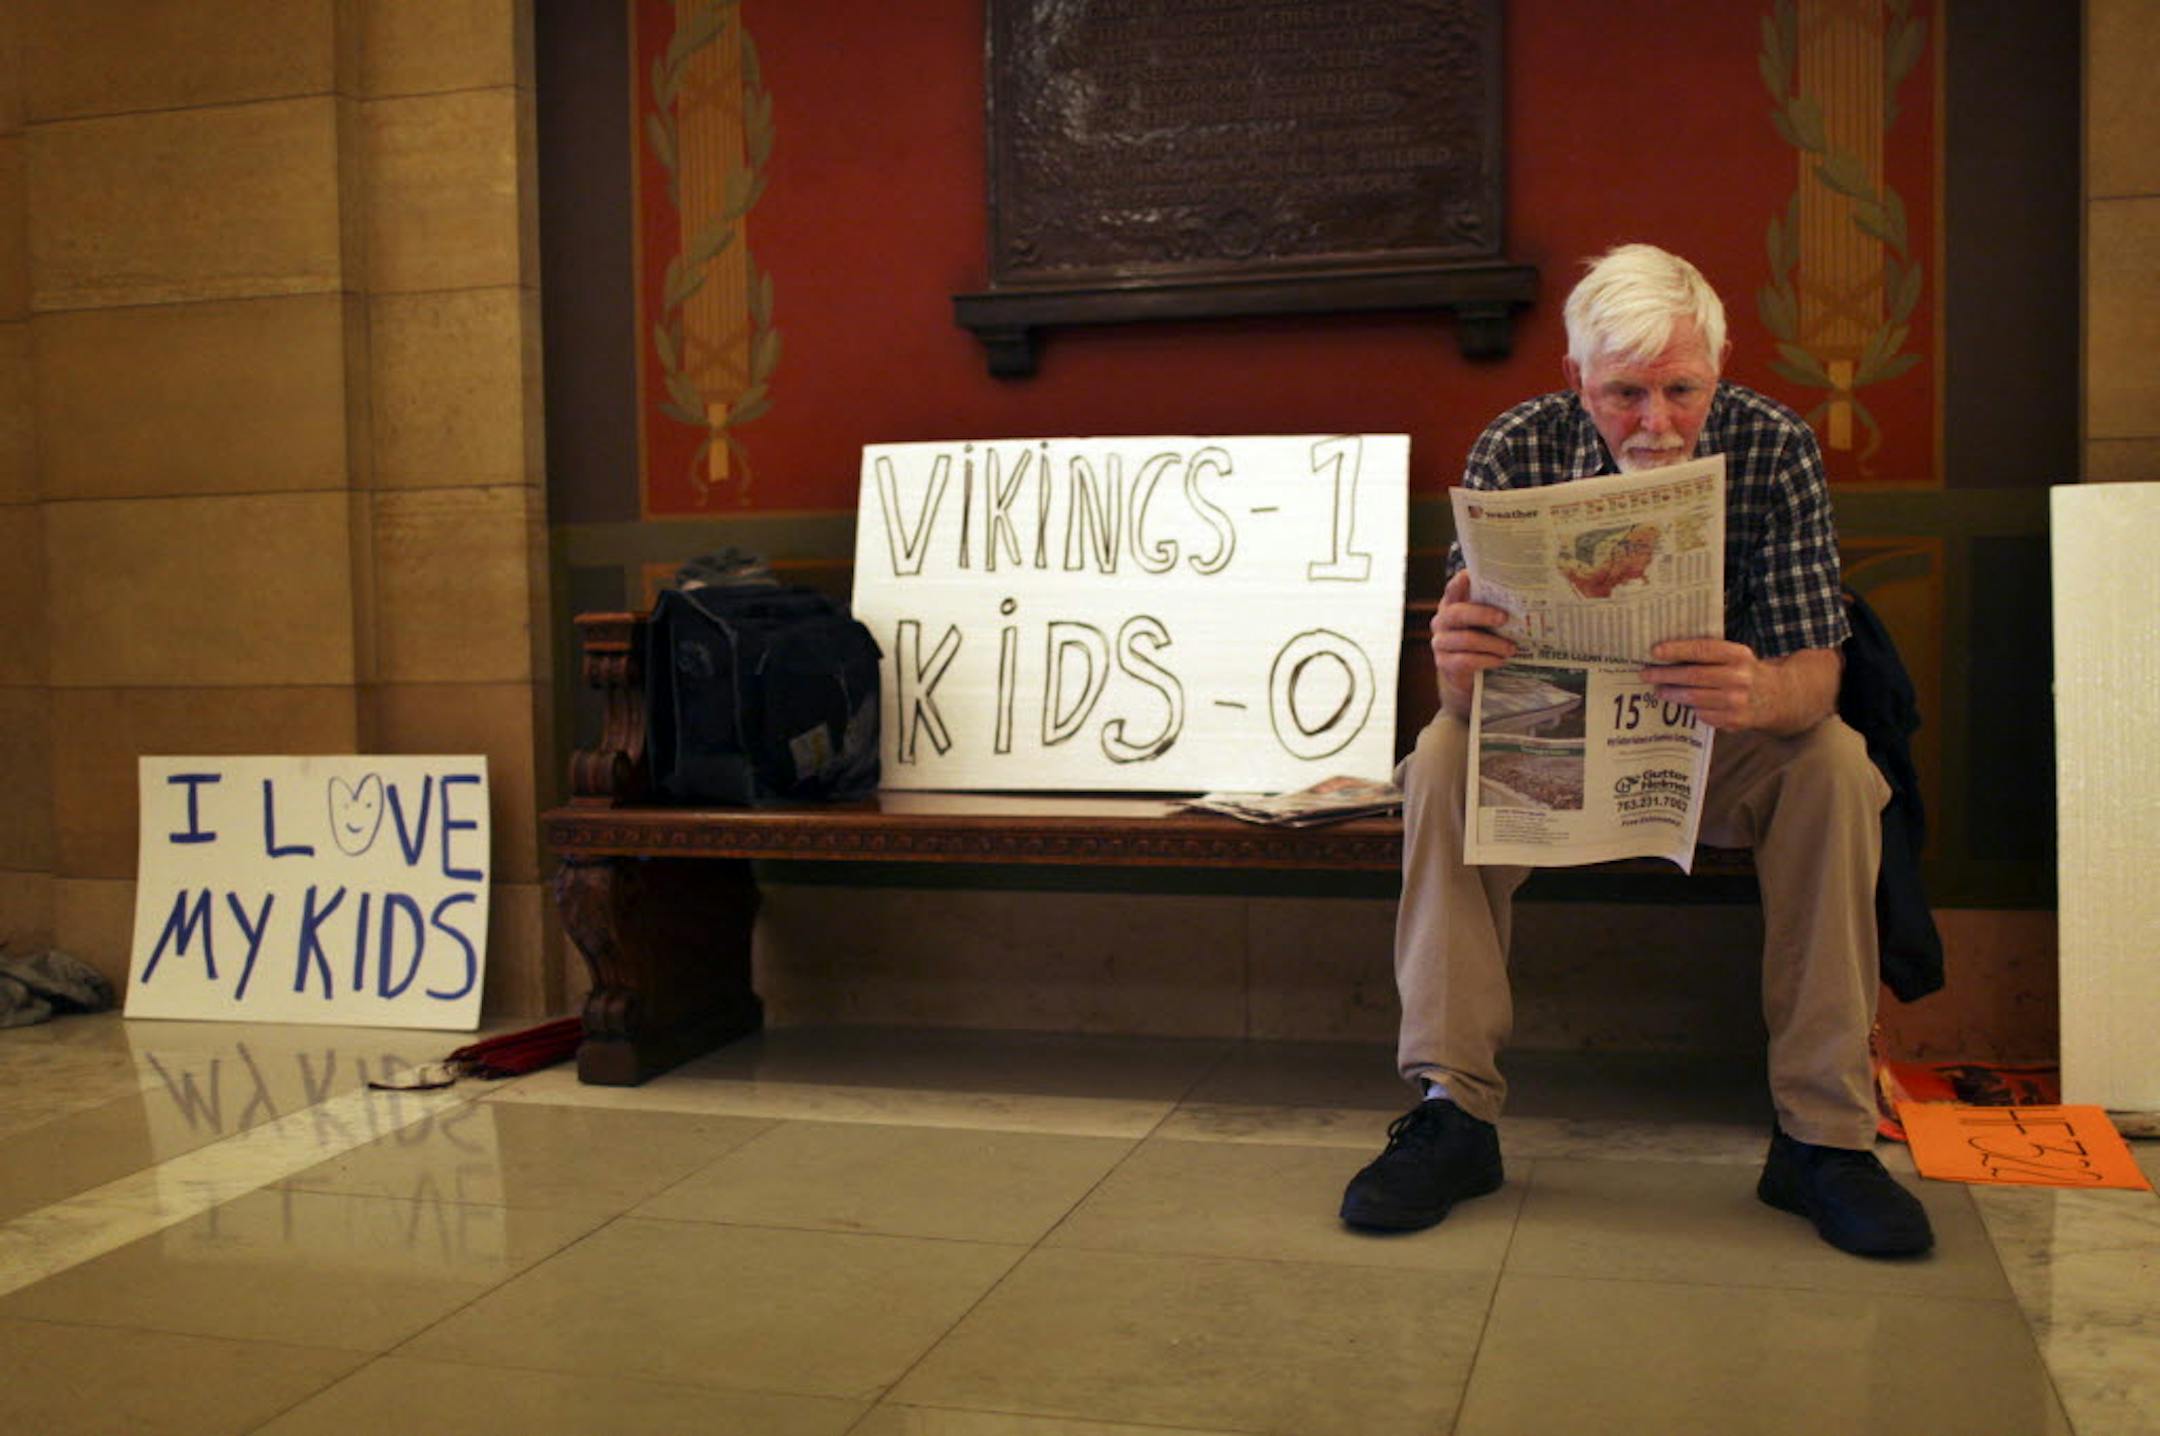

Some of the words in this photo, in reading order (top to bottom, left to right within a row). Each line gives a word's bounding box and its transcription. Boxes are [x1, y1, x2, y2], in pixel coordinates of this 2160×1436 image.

[1306, 435, 1373, 582] 1
[167, 772, 222, 844] I
[141, 887, 275, 1000] MY
[293, 884, 477, 1001] KIDS
